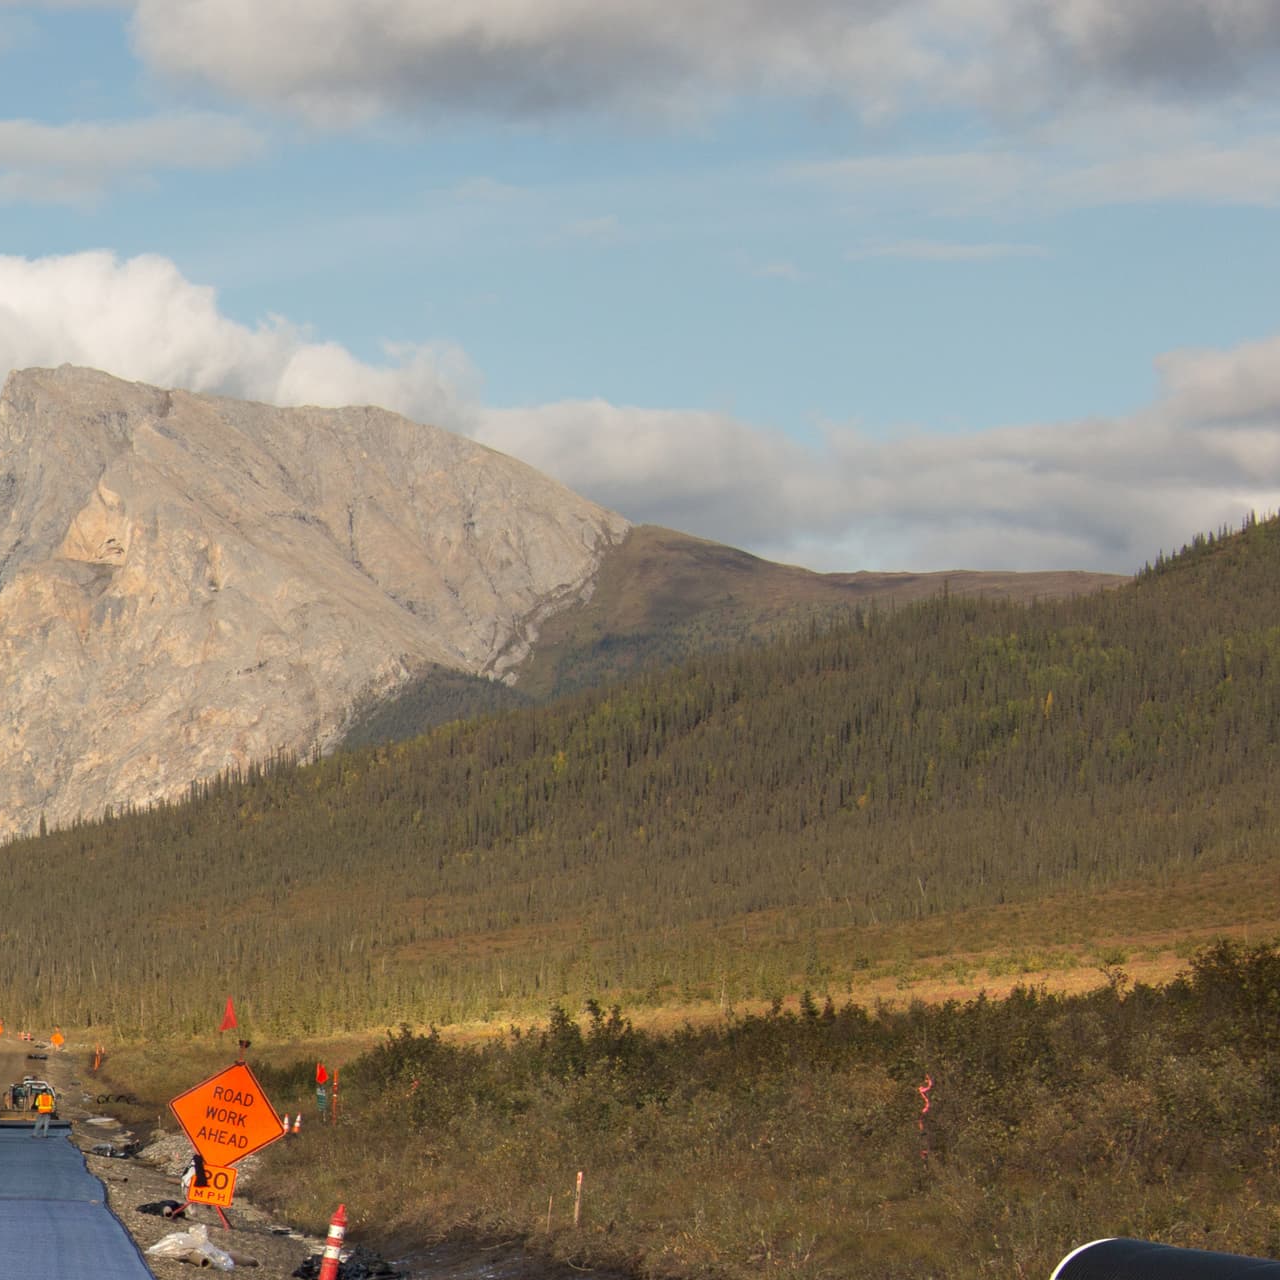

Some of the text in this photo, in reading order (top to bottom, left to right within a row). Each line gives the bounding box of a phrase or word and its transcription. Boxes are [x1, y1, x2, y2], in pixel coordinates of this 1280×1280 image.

[213, 1086, 254, 1107] ROAD
[205, 1105, 247, 1127] WORK
[196, 1126, 248, 1149] AHEAD
